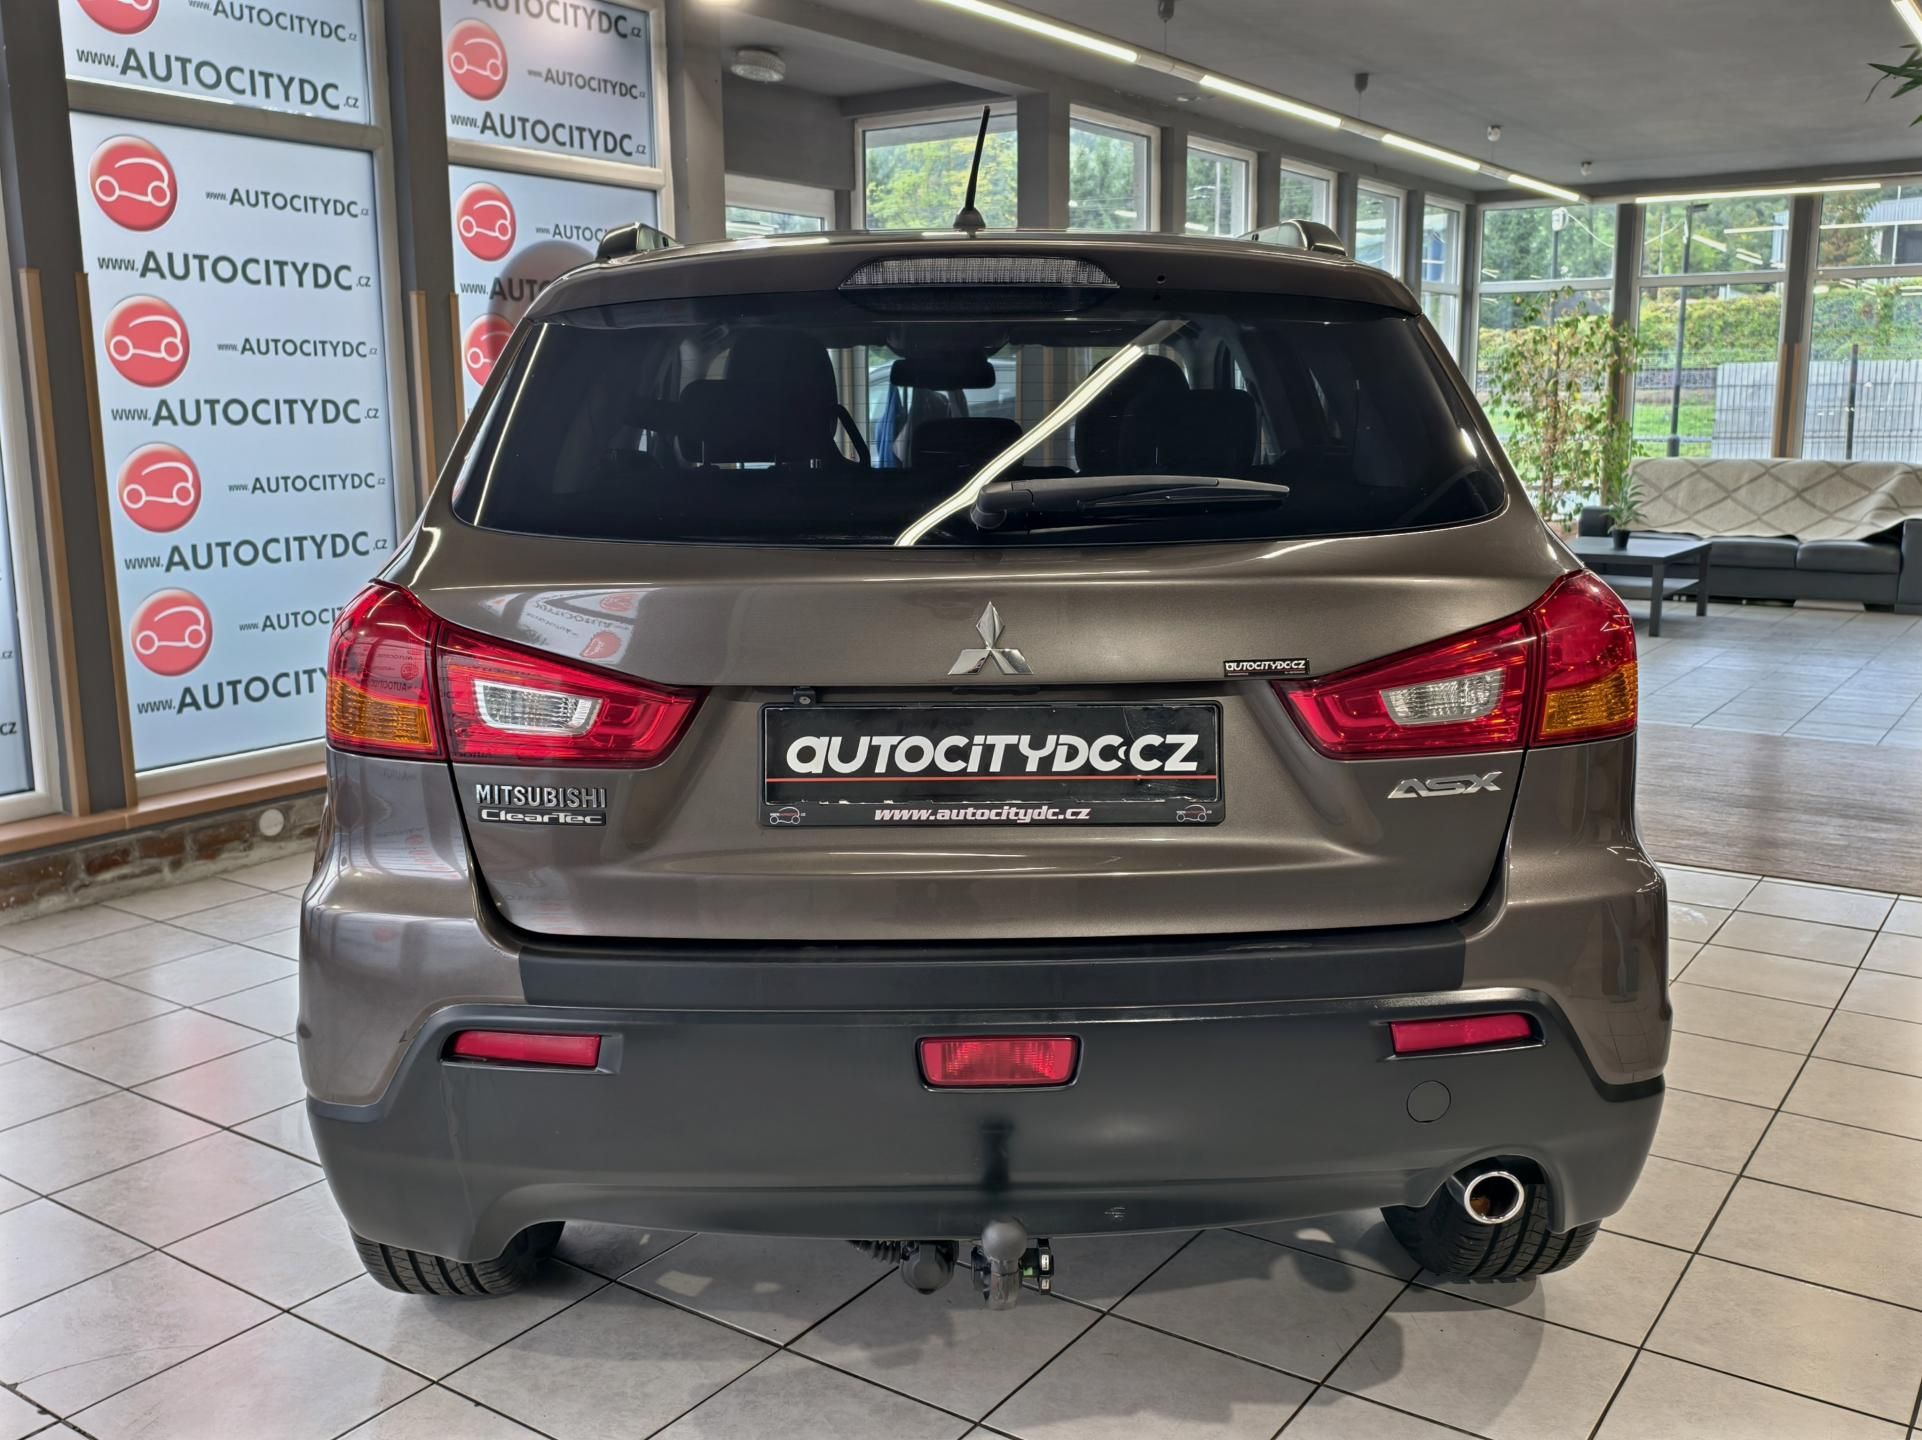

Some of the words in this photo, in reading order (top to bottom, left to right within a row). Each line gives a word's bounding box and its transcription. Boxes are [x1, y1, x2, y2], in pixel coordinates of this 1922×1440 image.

[76, 47, 359, 110] www.AUTOCITYDC.cz
[450, 111, 647, 157] www.AUTOCITYDC.cz
[98, 250, 371, 291] www.AUTOCITYDC.cz
[111, 398, 380, 426] www.AUTOCITYDC.cz
[124, 531, 388, 572] www.AUTOCITYDC.cz
[475, 784, 607, 808] MITSUBISHI
[1387, 770, 1503, 799] ASX
[481, 809, 603, 824] ClearTec
[874, 805, 1091, 824] www.autocitydc.cz
